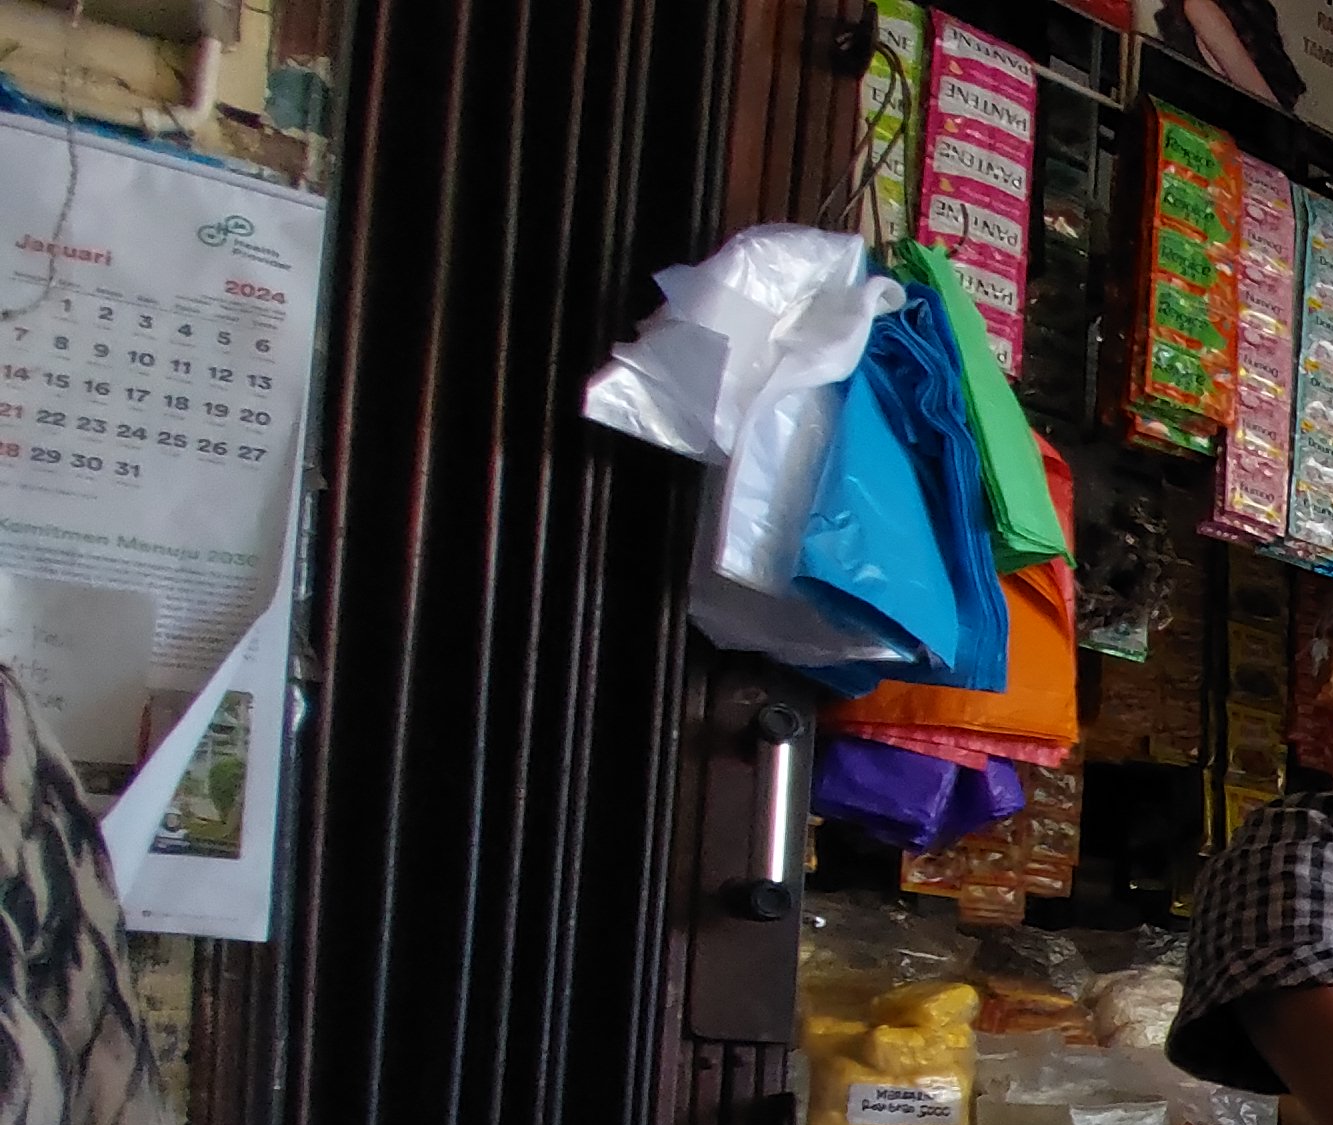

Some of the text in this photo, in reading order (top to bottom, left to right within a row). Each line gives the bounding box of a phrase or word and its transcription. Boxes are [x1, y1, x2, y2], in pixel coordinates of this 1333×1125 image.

[945, 82, 1028, 133] PANTENE
[224, 278, 287, 306] 2024
[61, 298, 271, 354] 1 2 3 4 5 6
[14, 326, 273, 391] 7 8 9 10 11 12 13
[3, 364, 272, 426] 14 15 16 17 18 19 20
[31, 446, 62, 464] 29
[70, 453, 104, 472] 30
[114, 461, 141, 478] 31
[36, 409, 67, 428] 22
[76, 416, 107, 434] 23
[117, 423, 148, 441] 24
[157, 431, 188, 449] 25
[197, 438, 228, 456] 26
[237, 445, 268, 462] 27
